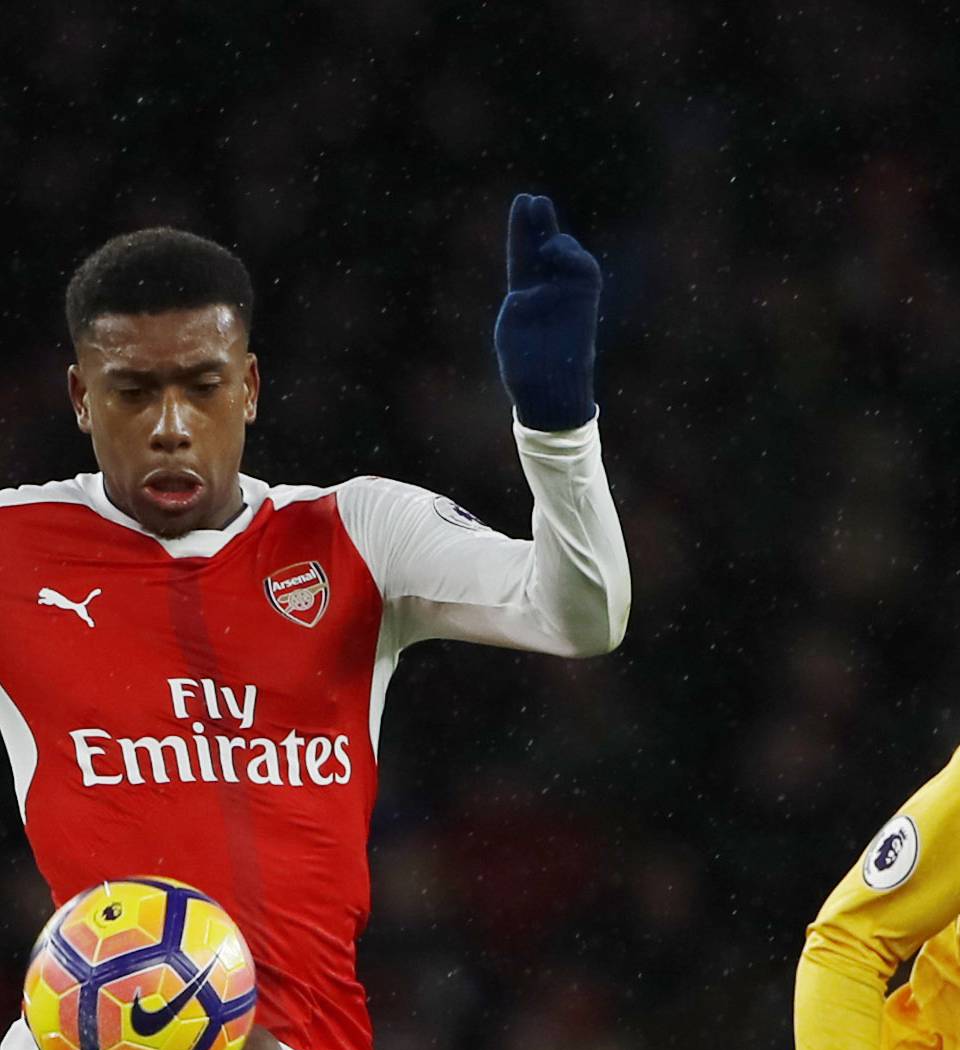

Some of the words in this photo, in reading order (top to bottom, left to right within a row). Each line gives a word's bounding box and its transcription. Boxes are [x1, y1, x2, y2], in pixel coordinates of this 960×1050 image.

[272, 569, 317, 592] Arsenal
[167, 678, 258, 729] Fly
[69, 722, 352, 787] Emirates
